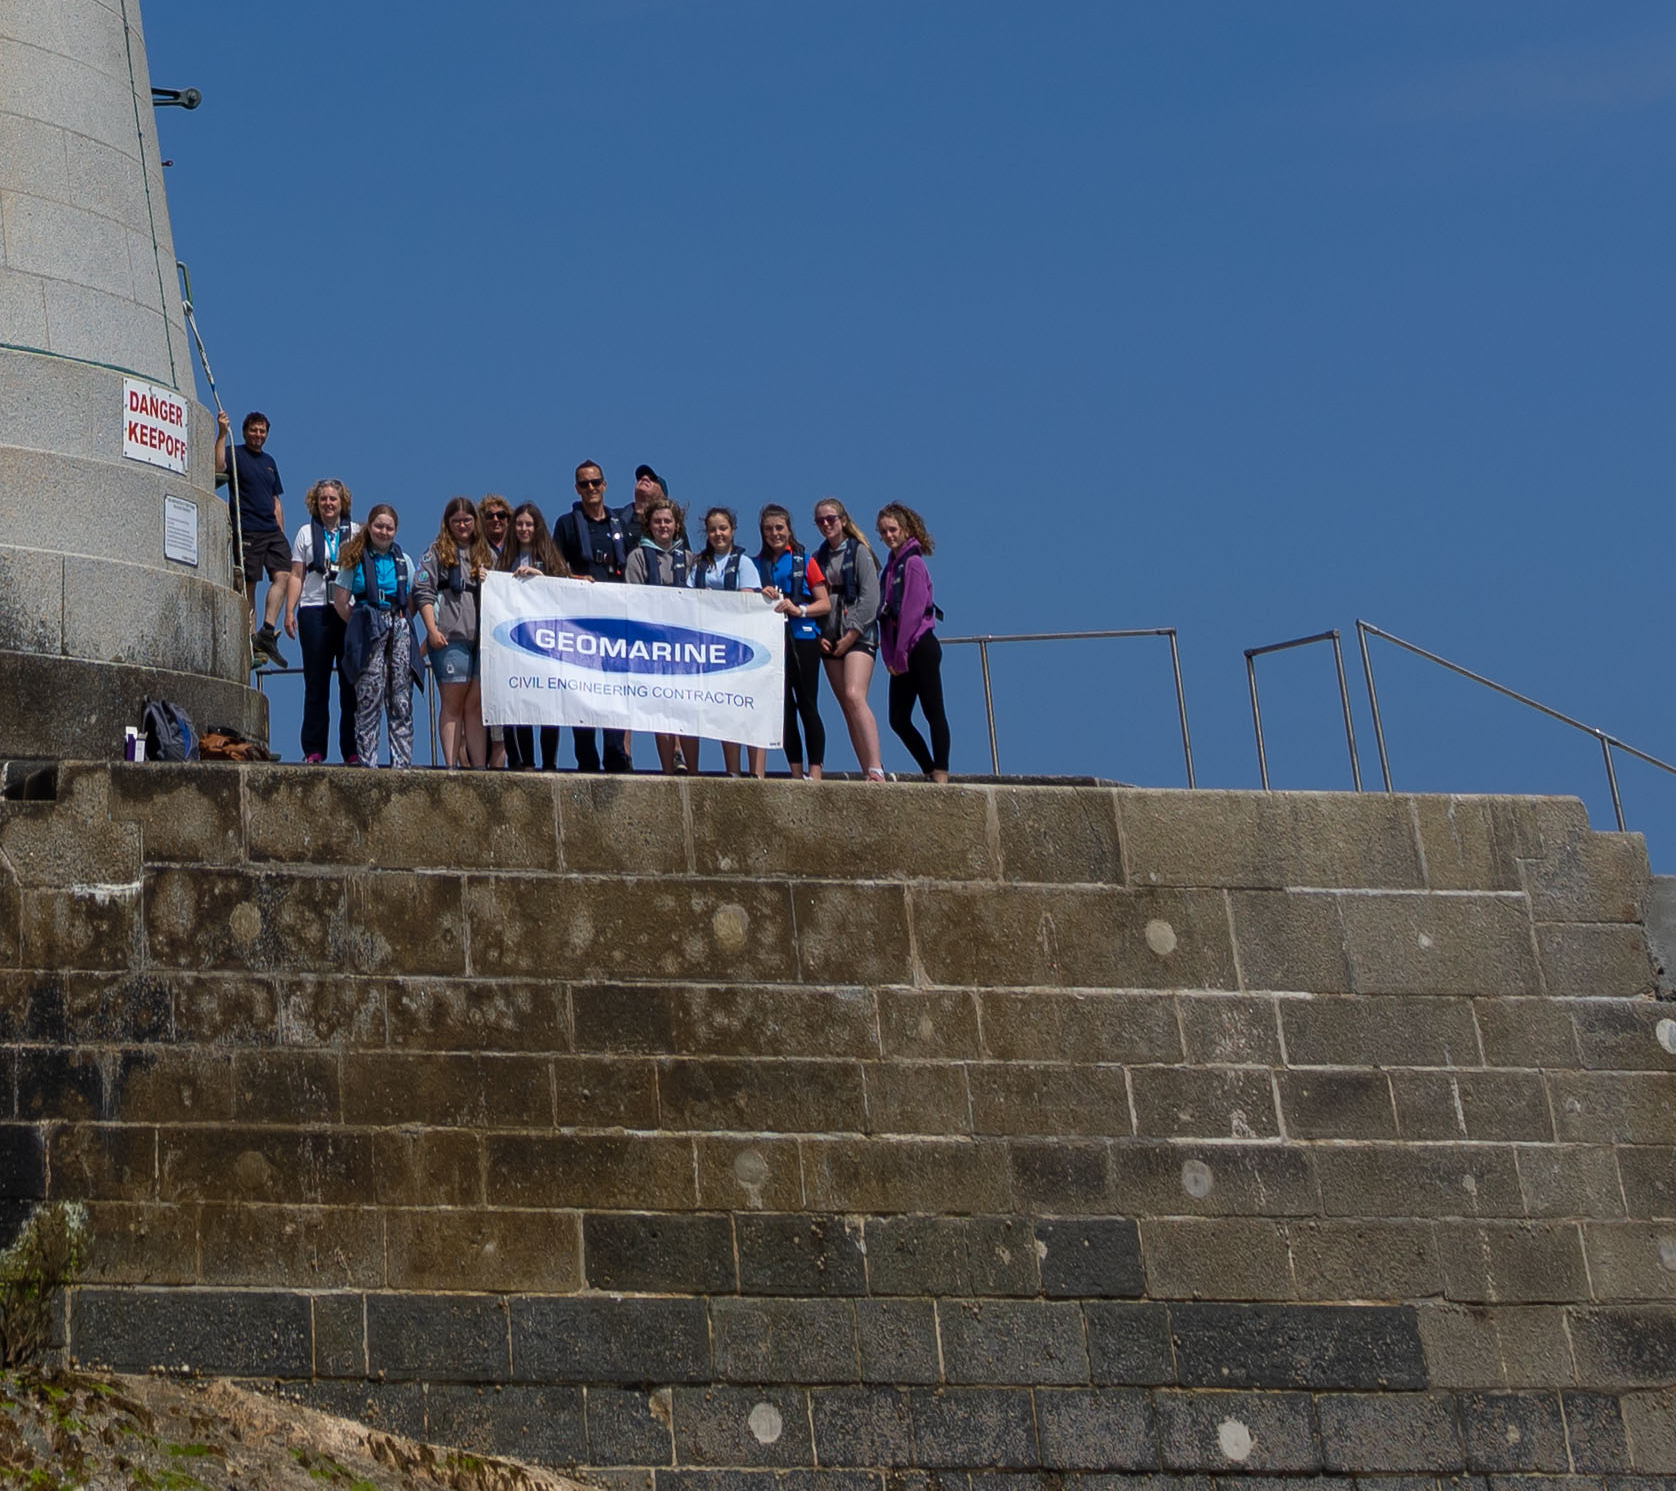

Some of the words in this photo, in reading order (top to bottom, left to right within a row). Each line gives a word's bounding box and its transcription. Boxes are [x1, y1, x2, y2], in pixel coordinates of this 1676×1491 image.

[129, 390, 183, 428] DANGER
[535, 628, 727, 664] GEOMARINE
[508, 676, 544, 689] CIVIL
[548, 677, 648, 698] ENGINEERING
[652, 686, 755, 709] CONTRACTOR
